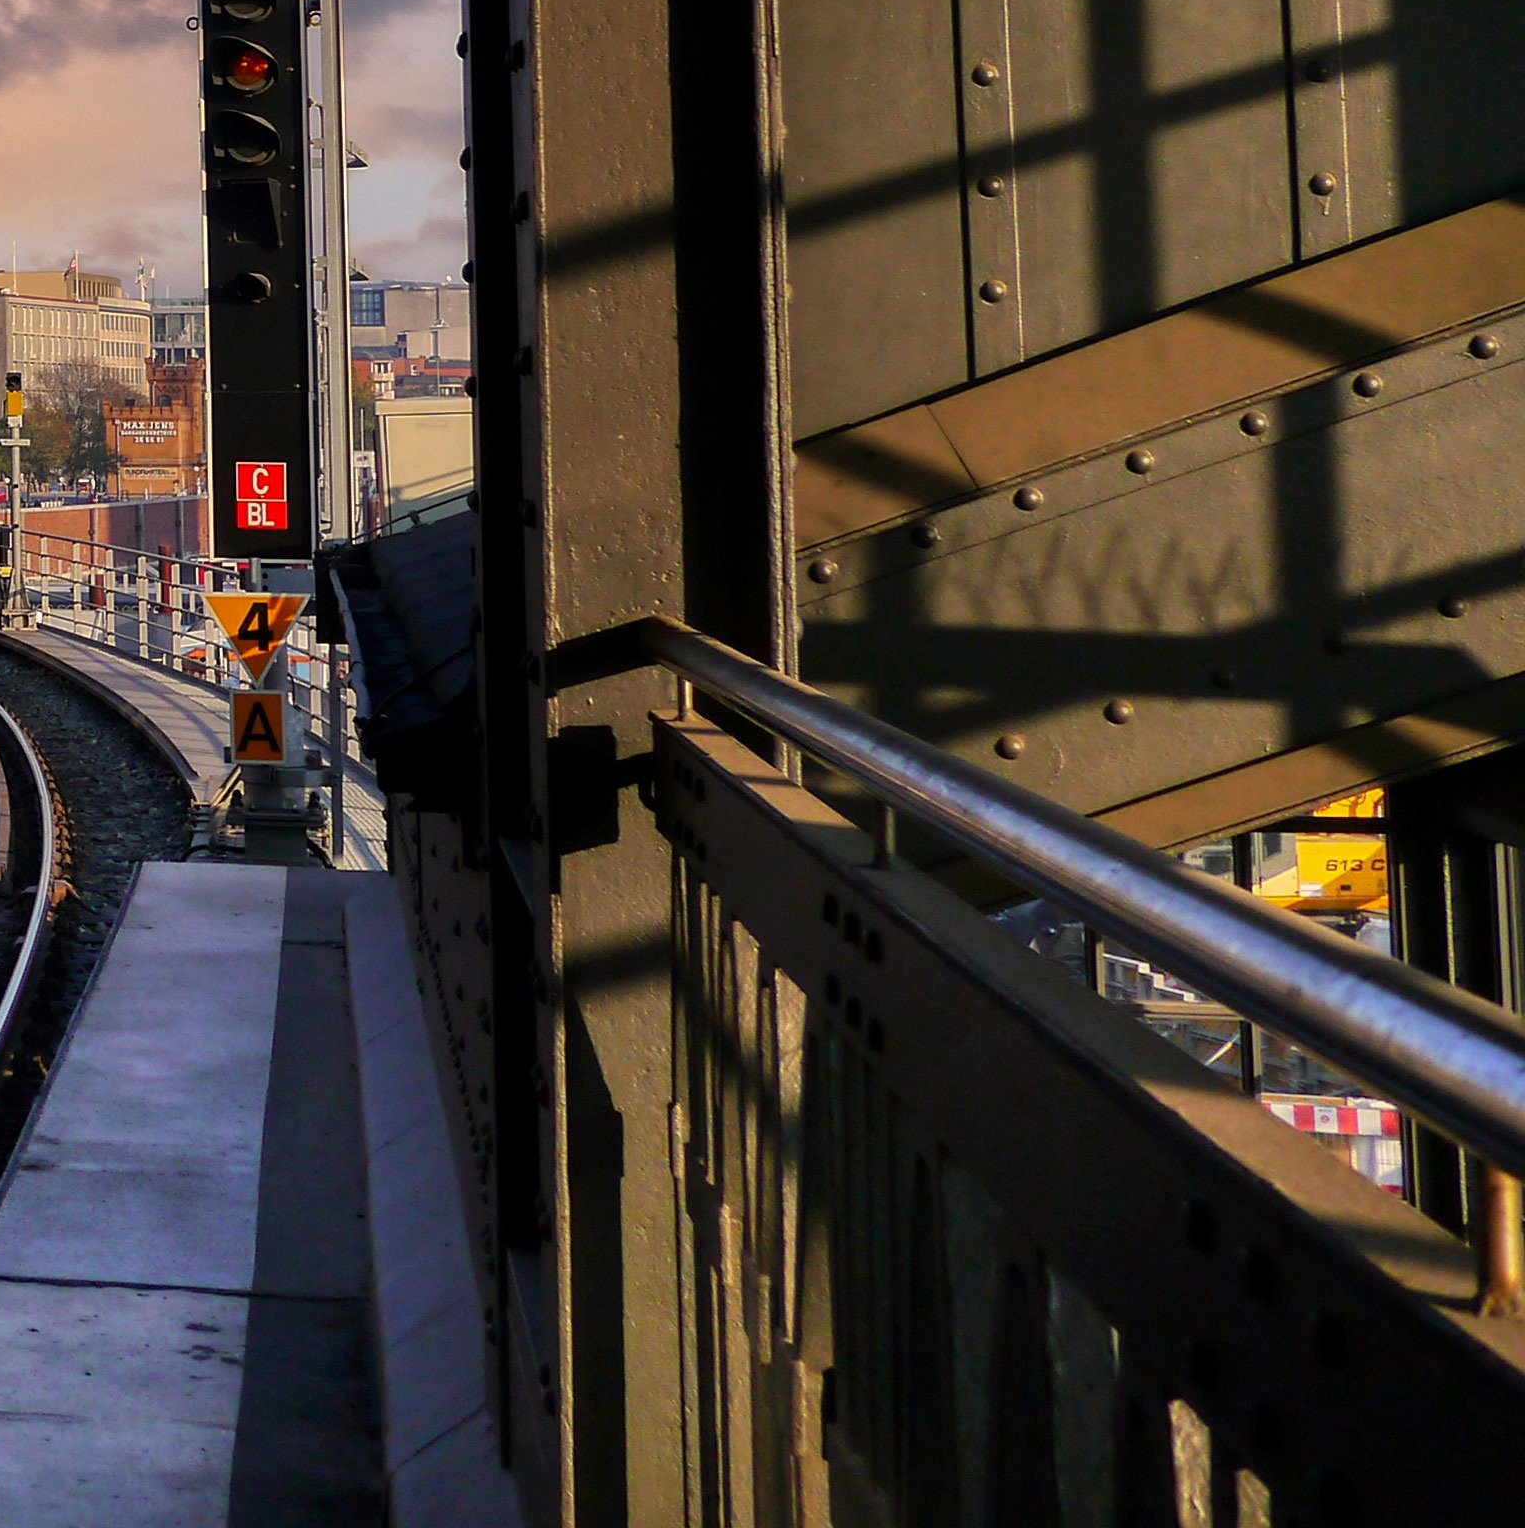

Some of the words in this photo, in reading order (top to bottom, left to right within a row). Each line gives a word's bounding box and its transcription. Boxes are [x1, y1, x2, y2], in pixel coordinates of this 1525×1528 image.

[122, 421, 145, 430] MAX
[149, 421, 175, 430] JENS
[252, 467, 269, 496] C
[247, 502, 275, 527] BL
[237, 602, 275, 652] 4
[236, 701, 280, 753] A
[1325, 859, 1363, 872] 613
[1371, 859, 1385, 871] C
